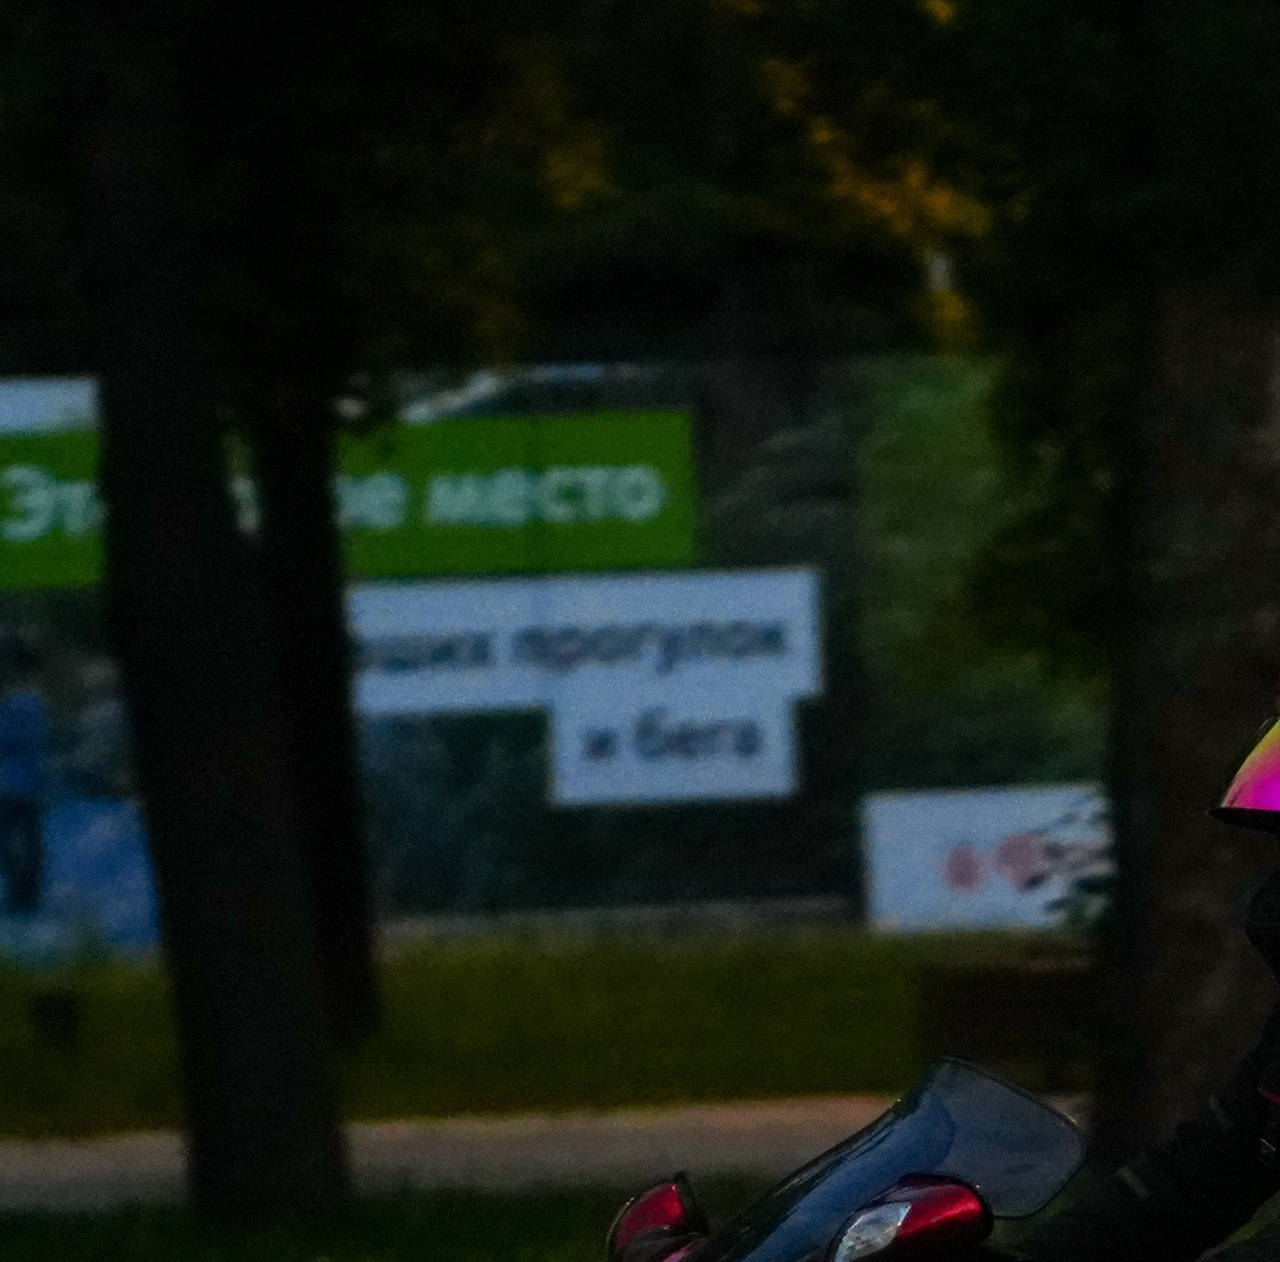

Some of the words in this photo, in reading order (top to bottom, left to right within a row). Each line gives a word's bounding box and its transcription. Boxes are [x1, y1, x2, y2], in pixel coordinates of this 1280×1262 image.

[1, 464, 106, 541] Эт
[427, 464, 664, 528] место
[636, 704, 761, 759] бега
